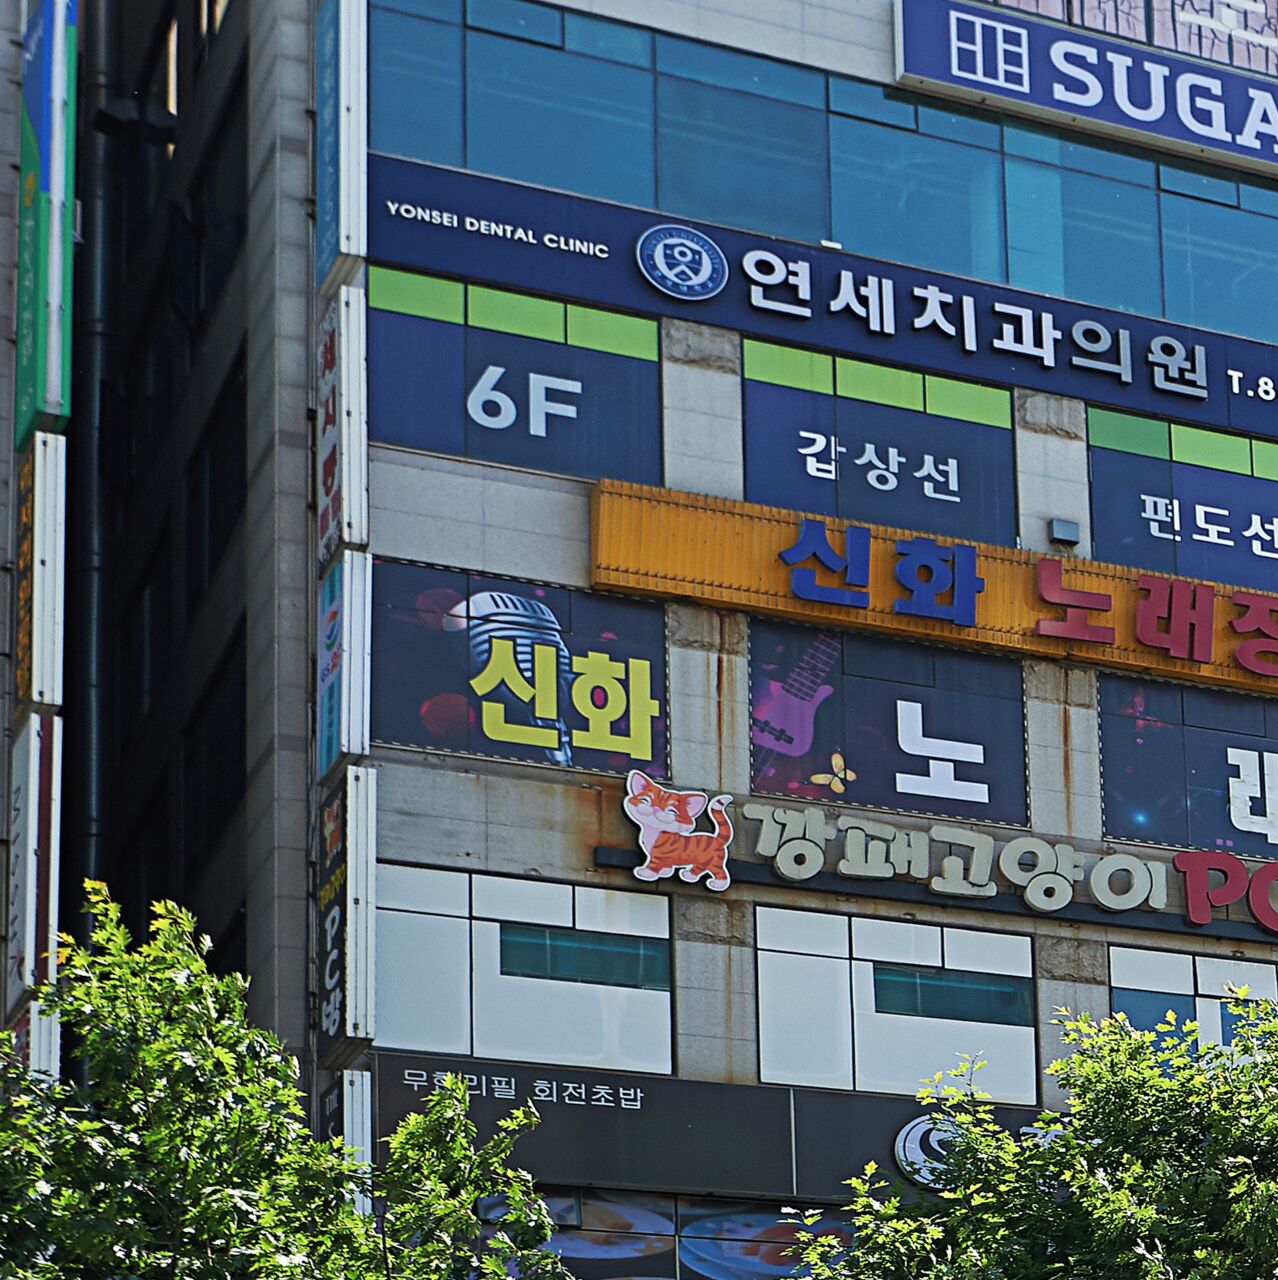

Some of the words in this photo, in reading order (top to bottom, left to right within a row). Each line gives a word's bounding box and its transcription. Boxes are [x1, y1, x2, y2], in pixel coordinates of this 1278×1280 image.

[386, 200, 459, 228] YONSEI
[464, 216, 538, 245] DENTAL
[543, 232, 609, 259] CLINIC
[742, 248, 1209, 401] 연세치과의원
[466, 365, 583, 437] 6F
[797, 429, 962, 503] 갑상선
[776, 519, 986, 627] 신화
[469, 636, 661, 762] 신화
[532, 1078, 645, 1111] 회전초밥
